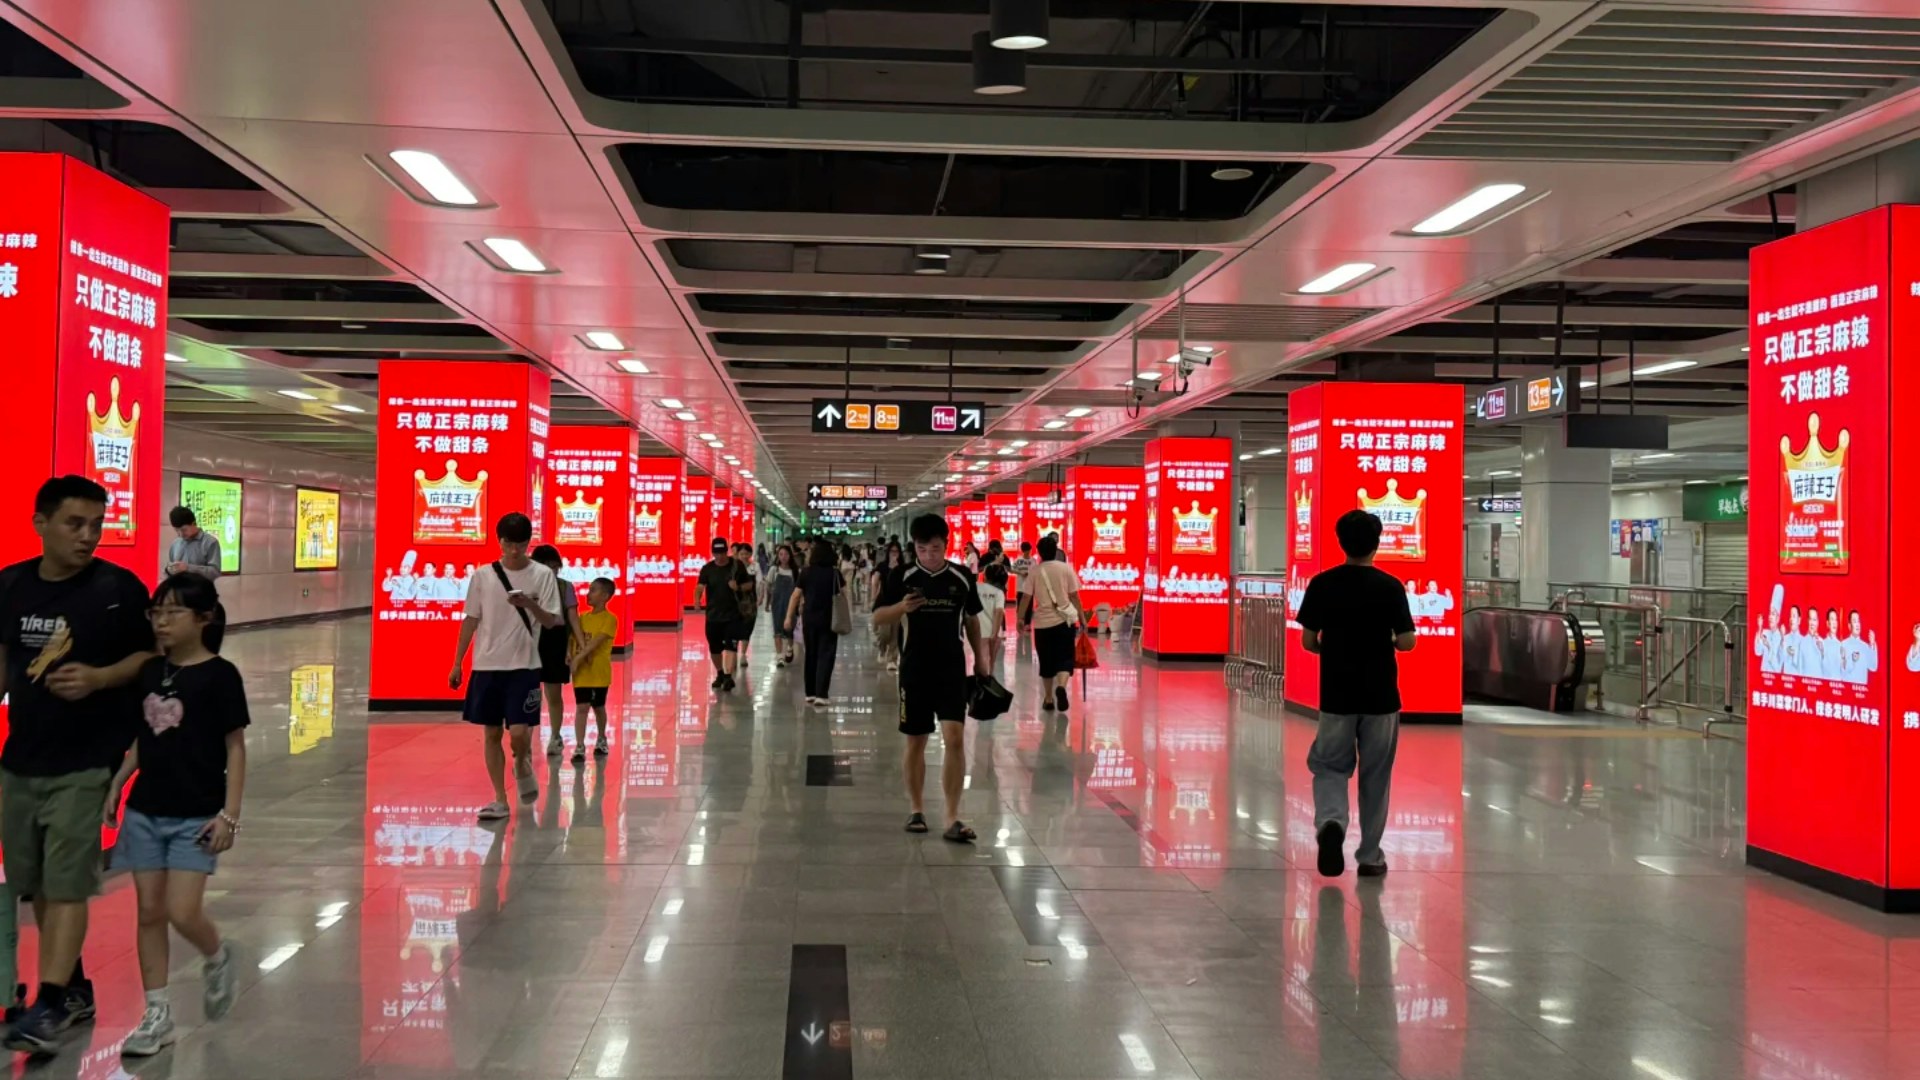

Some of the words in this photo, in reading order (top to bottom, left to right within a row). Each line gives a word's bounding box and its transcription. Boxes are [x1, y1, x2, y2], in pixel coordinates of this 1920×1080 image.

[0, 233, 38, 249] 麻辣
[75, 273, 156, 329] 只做正宗麻辣
[88, 325, 142, 368] 不做甜条
[1763, 313, 1870, 367] 只做正宗麻辣
[1780, 364, 1851, 405] 不做甜条
[396, 411, 510, 432] 只做正宗麻辣
[414, 435, 490, 454] 不做甜条
[1340, 432, 1447, 452] 只做正宗麻辣
[1357, 455, 1428, 474] 不做甜条
[428, 491, 474, 506] 麻辣王子
